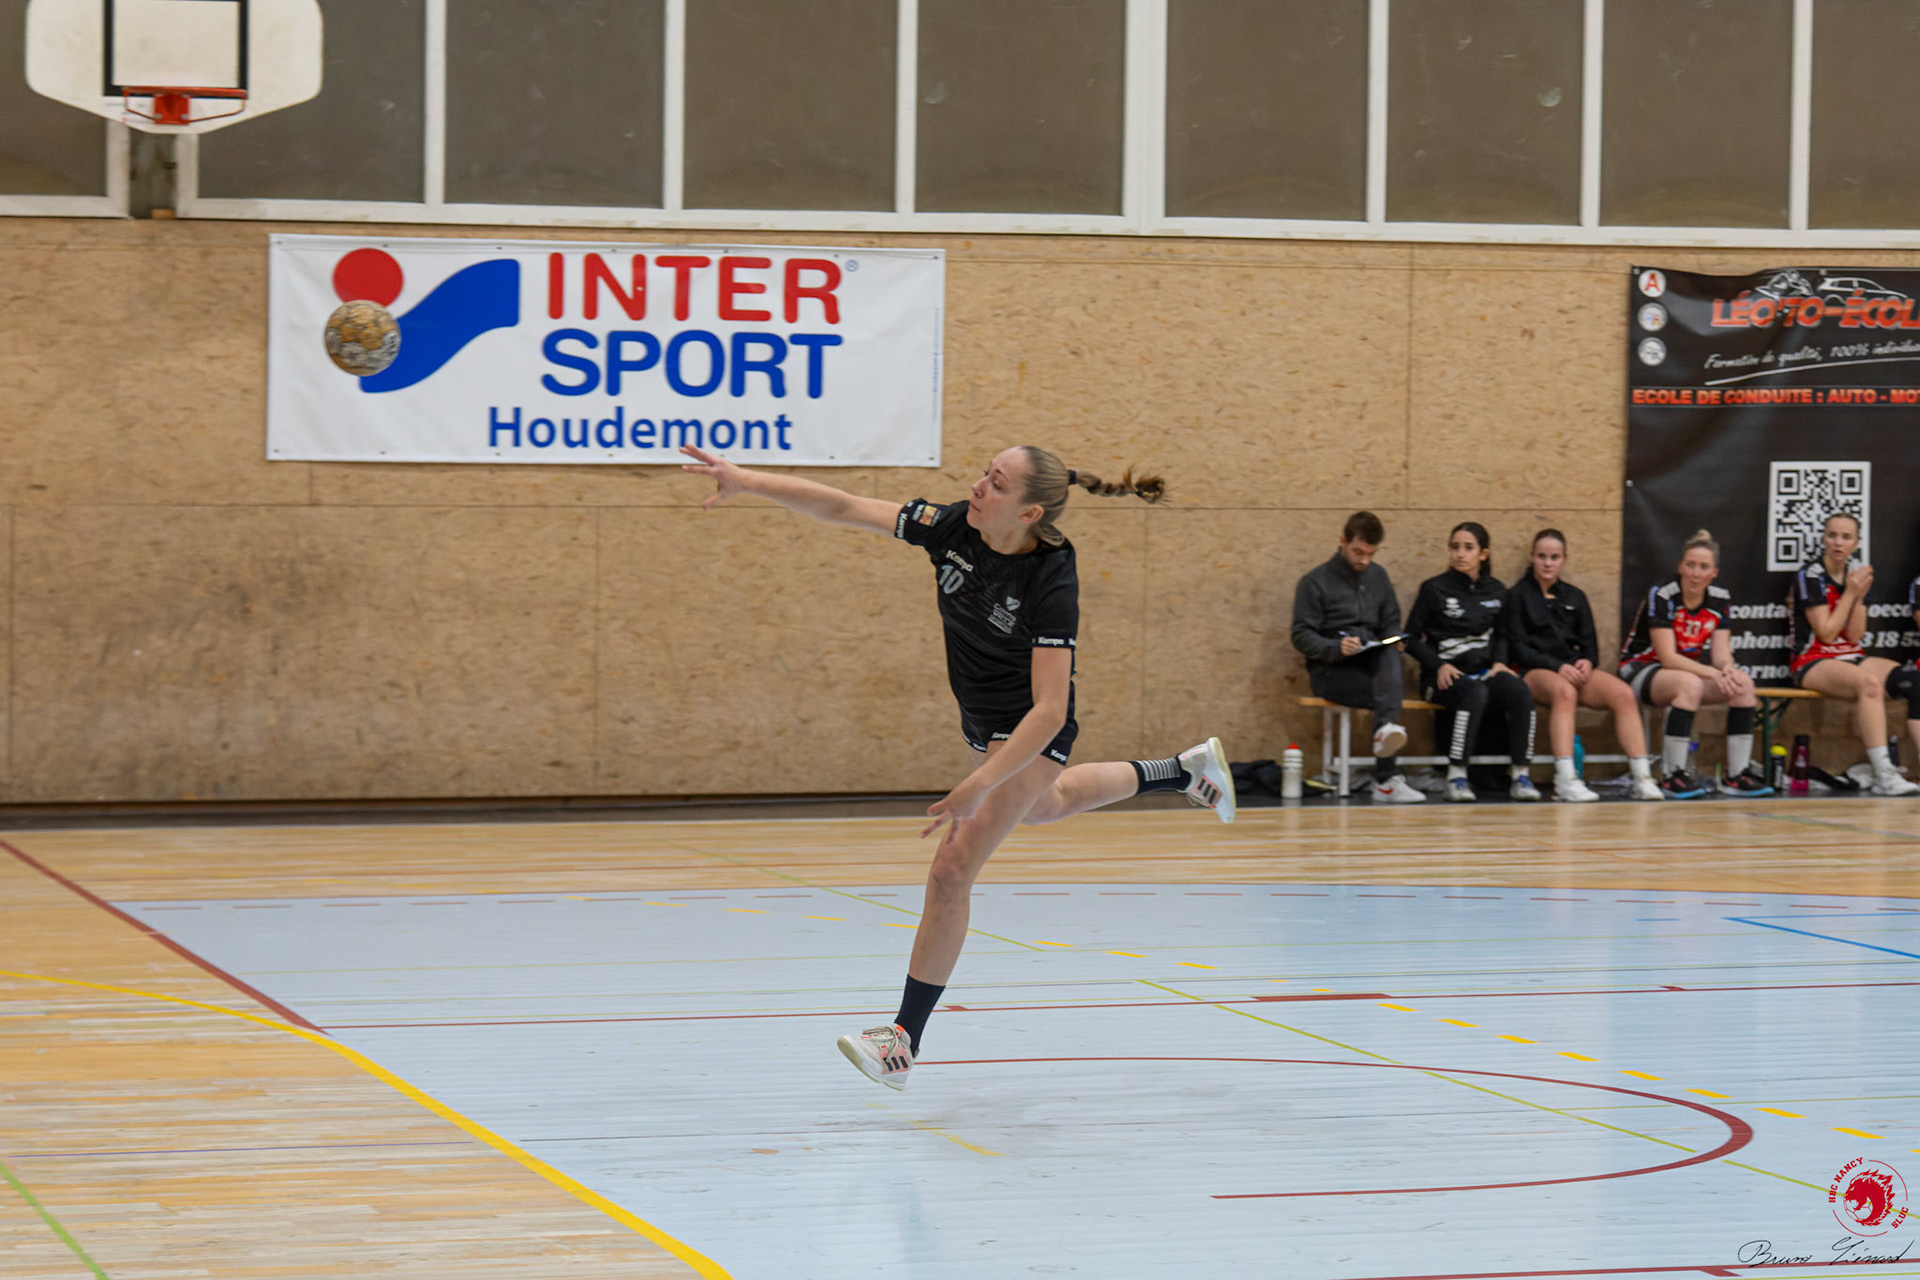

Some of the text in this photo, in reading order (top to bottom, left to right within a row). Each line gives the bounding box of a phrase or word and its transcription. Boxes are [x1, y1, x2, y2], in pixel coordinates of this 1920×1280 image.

[548, 251, 842, 325] INTER
[541, 328, 844, 399] SPORT
[1703, 353, 1760, 369] Formation
[1632, 388, 1692, 405] ECOLE
[1697, 389, 1722, 405] DE
[1724, 388, 1813, 405] CONDUITE
[1827, 388, 1878, 404] AUTO
[1889, 388, 1920, 404] MO
[488, 407, 792, 450] Houdemont
[945, 549, 974, 573] Kempa
[938, 564, 965, 595] 10
[1729, 603, 1789, 619] conta
[1038, 636, 1064, 646] Kempa
[1050, 748, 1067, 762] Kemp
